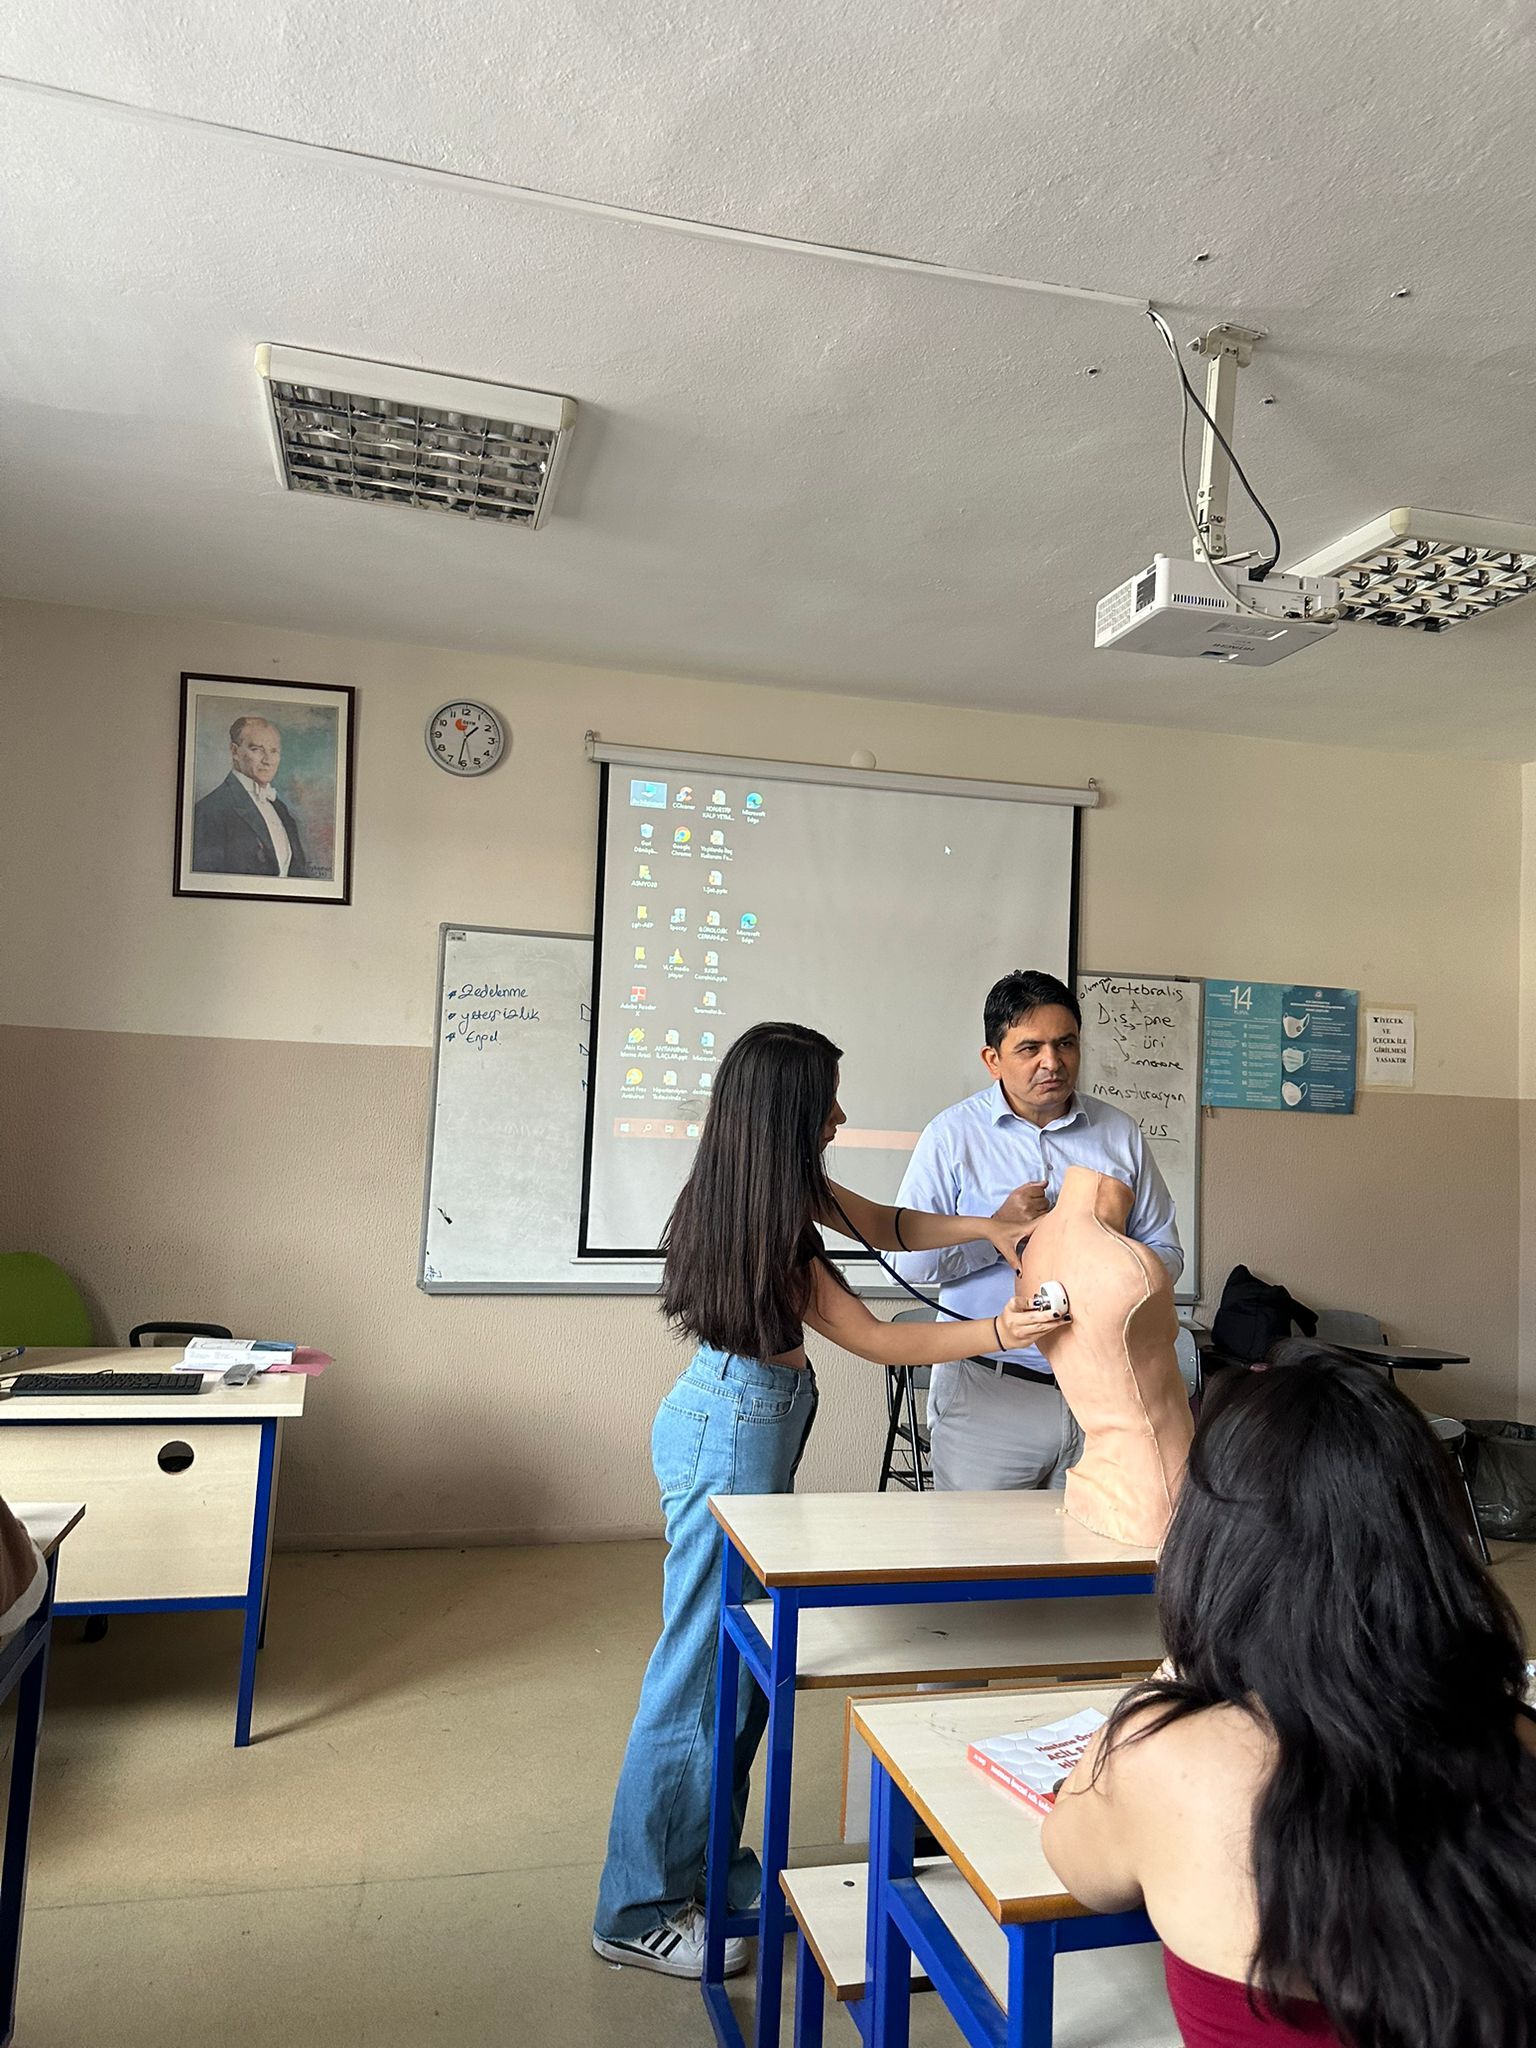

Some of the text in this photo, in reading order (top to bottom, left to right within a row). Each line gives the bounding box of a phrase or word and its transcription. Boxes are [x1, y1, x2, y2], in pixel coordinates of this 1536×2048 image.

[462, 708, 471, 716] 12
[440, 719, 448, 727] 10
[488, 737, 495, 745] 3
[447, 754, 454, 762] 7
[460, 760, 467, 768] 6
[741, 809, 766, 817] Microsoft
[747, 816, 760, 825] Edge
[672, 842, 691, 851] Google
[736, 929, 761, 938] Microsoft
[741, 937, 754, 945] Edge
[1101, 982, 1184, 1002] Vertebralis
[1230, 985, 1253, 1010] 14
[1035, 1739, 1077, 1752] Hastane
[1047, 1749, 1079, 1761] ACİL
